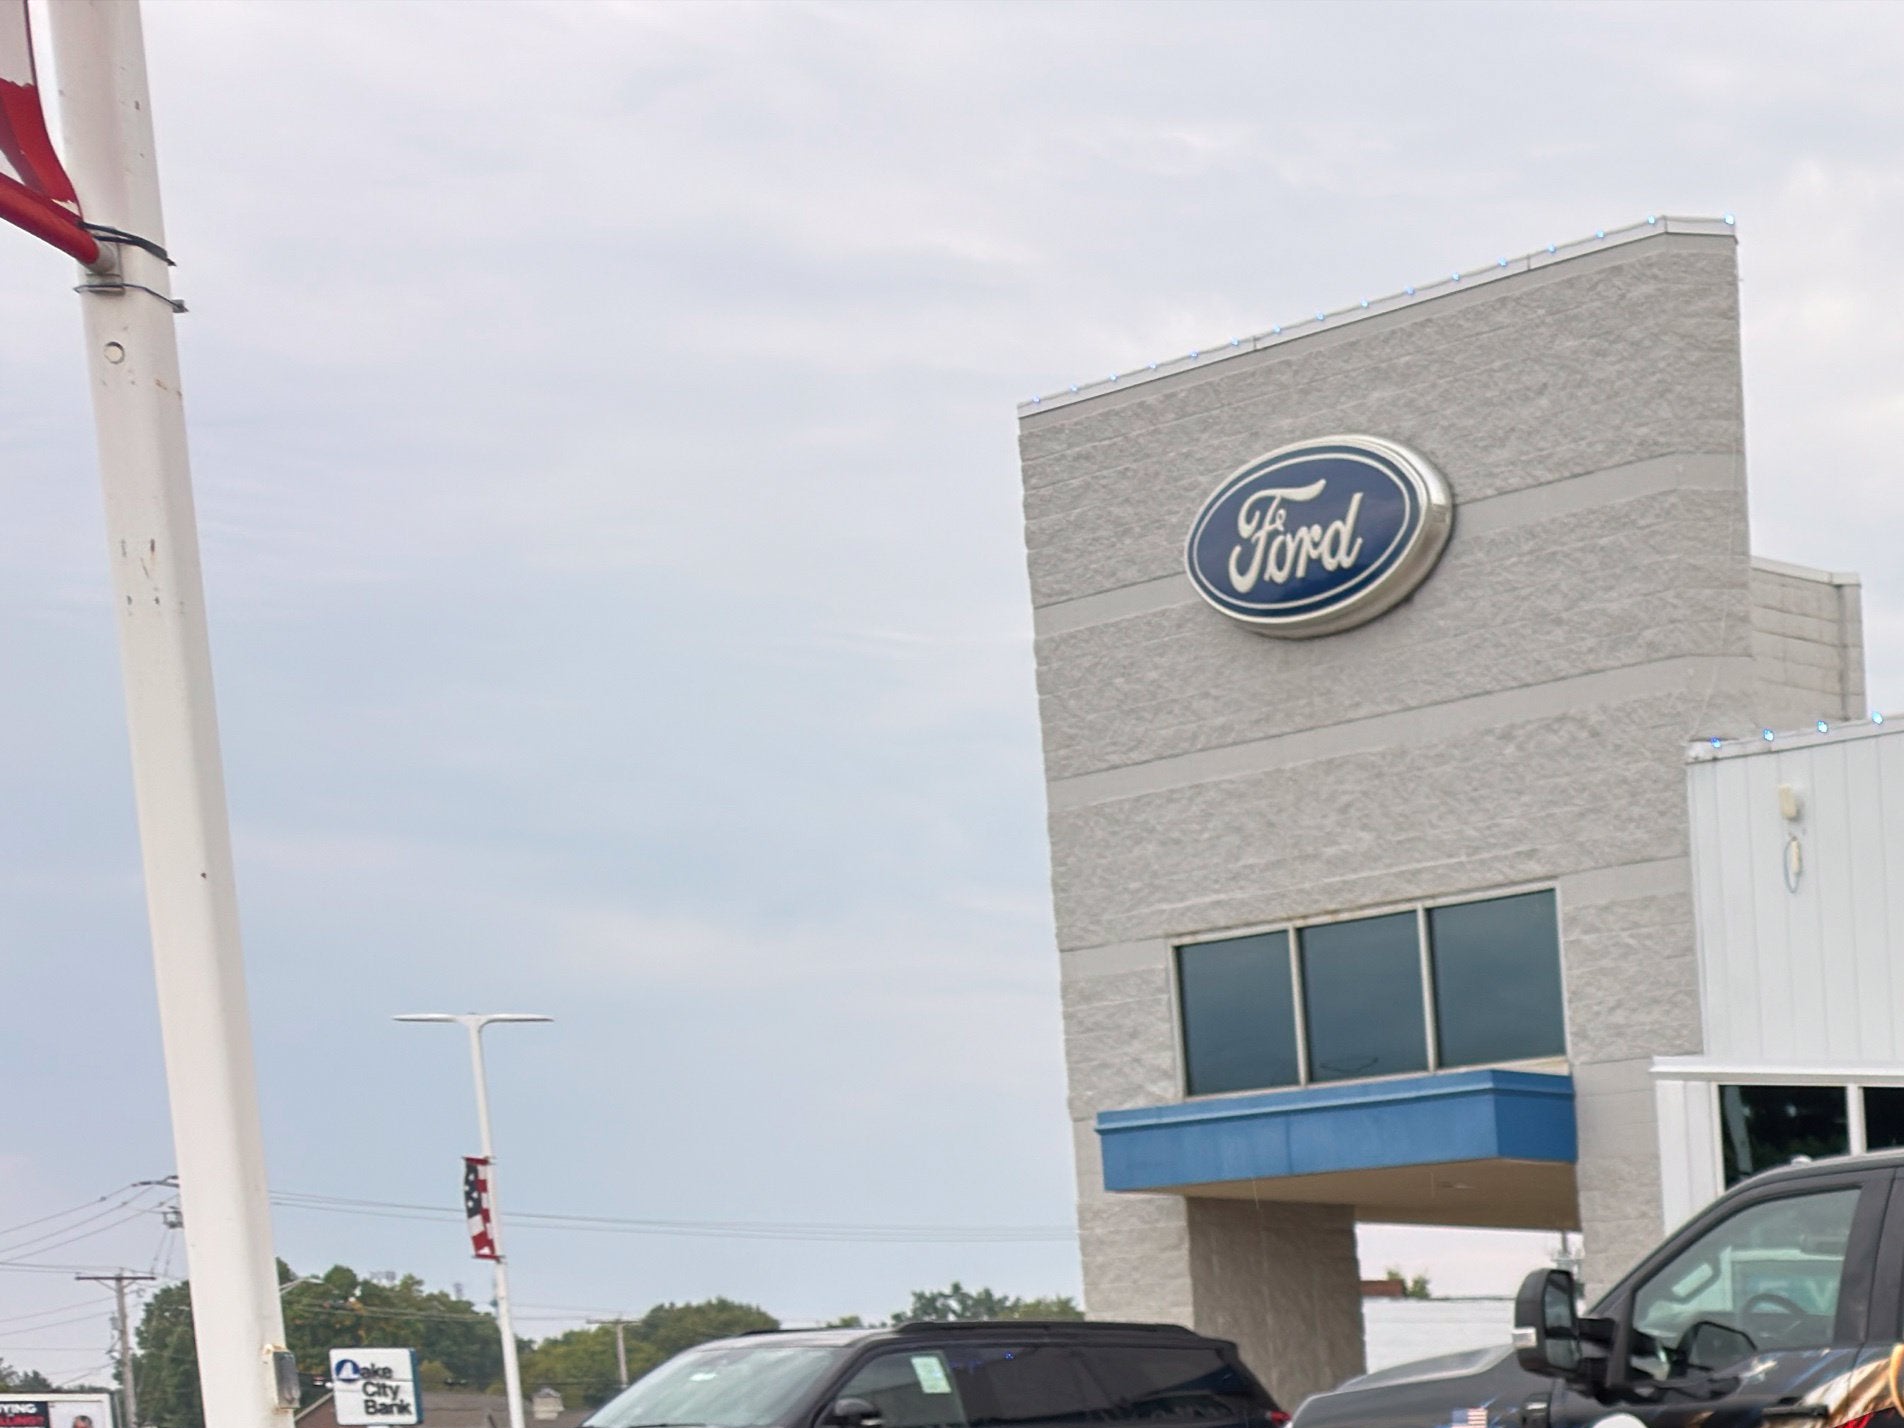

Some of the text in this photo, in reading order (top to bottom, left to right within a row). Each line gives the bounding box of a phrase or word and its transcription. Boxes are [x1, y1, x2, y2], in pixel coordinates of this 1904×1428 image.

[1228, 478, 1364, 594] Ford
[335, 1359, 393, 1382] Lake
[362, 1381, 400, 1400] City
[364, 1399, 412, 1416] Bank
